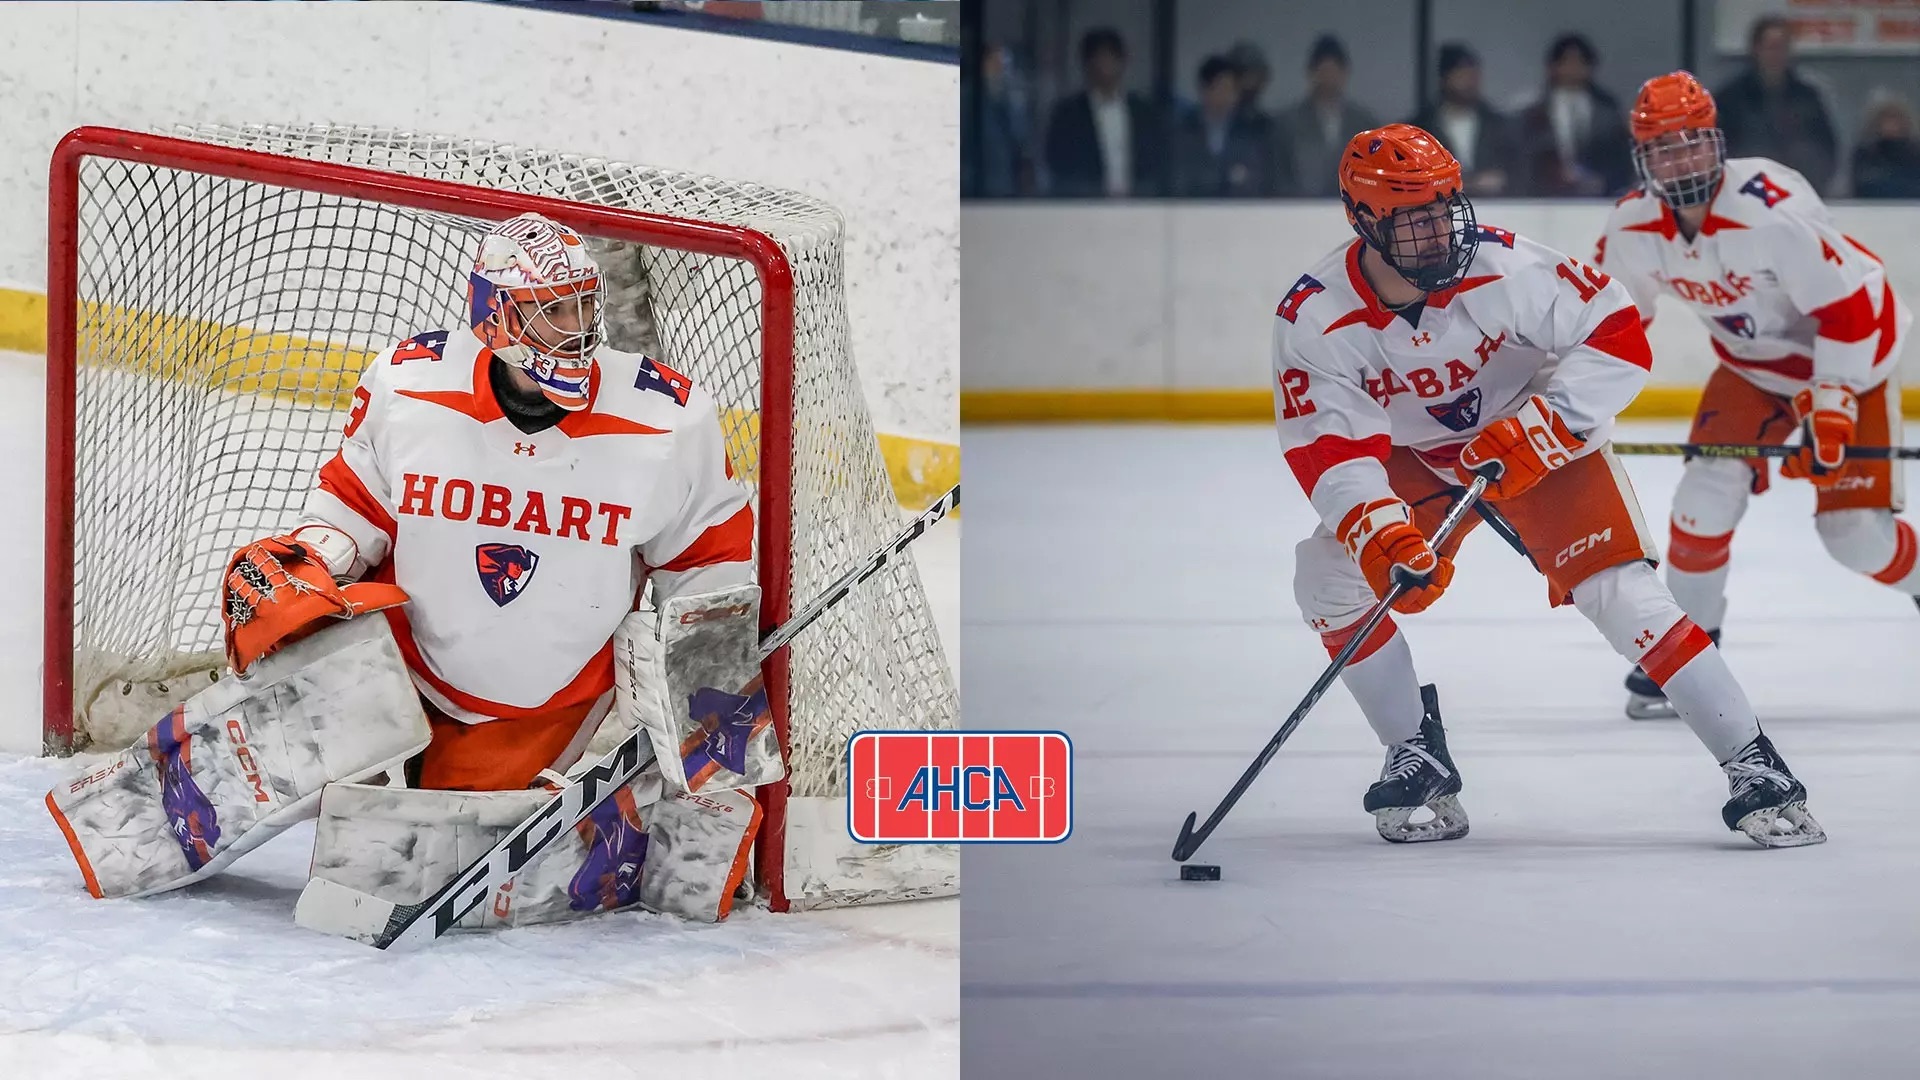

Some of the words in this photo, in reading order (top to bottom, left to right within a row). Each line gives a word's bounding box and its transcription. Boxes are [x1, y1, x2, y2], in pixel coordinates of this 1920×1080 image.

[553, 266, 594, 283] CCM
[1277, 368, 1317, 420] 12
[398, 473, 632, 547] HOBART
[1408, 551, 1430, 566] CCM
[1555, 527, 1612, 568] CCM
[226, 719, 270, 803] CCM
[429, 732, 638, 939] CCM
